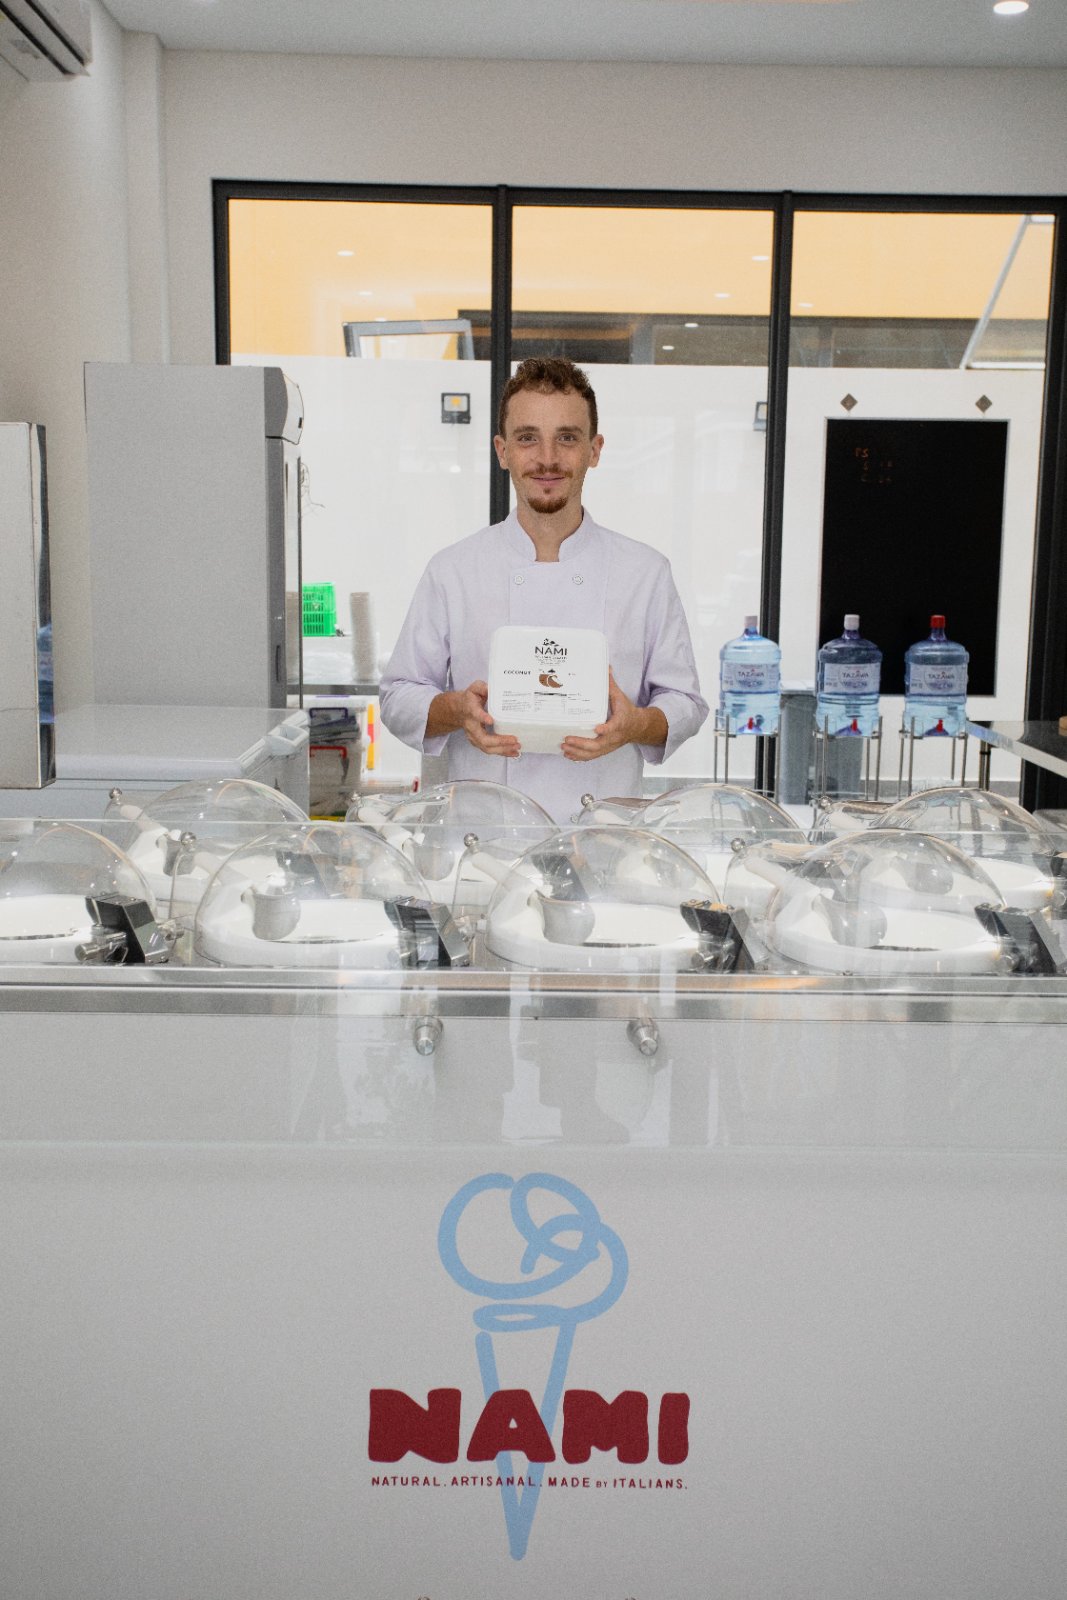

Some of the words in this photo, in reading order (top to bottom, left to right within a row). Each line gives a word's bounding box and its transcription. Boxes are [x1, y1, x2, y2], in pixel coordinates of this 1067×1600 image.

[534, 646, 568, 656] NAMI
[368, 1388, 691, 1465] NAMI
[371, 1475, 447, 1487] NATURAL.
[548, 1477, 590, 1488] MADE
[595, 1480, 608, 1488] BY
[612, 1478, 688, 1490] ITALIANS.
